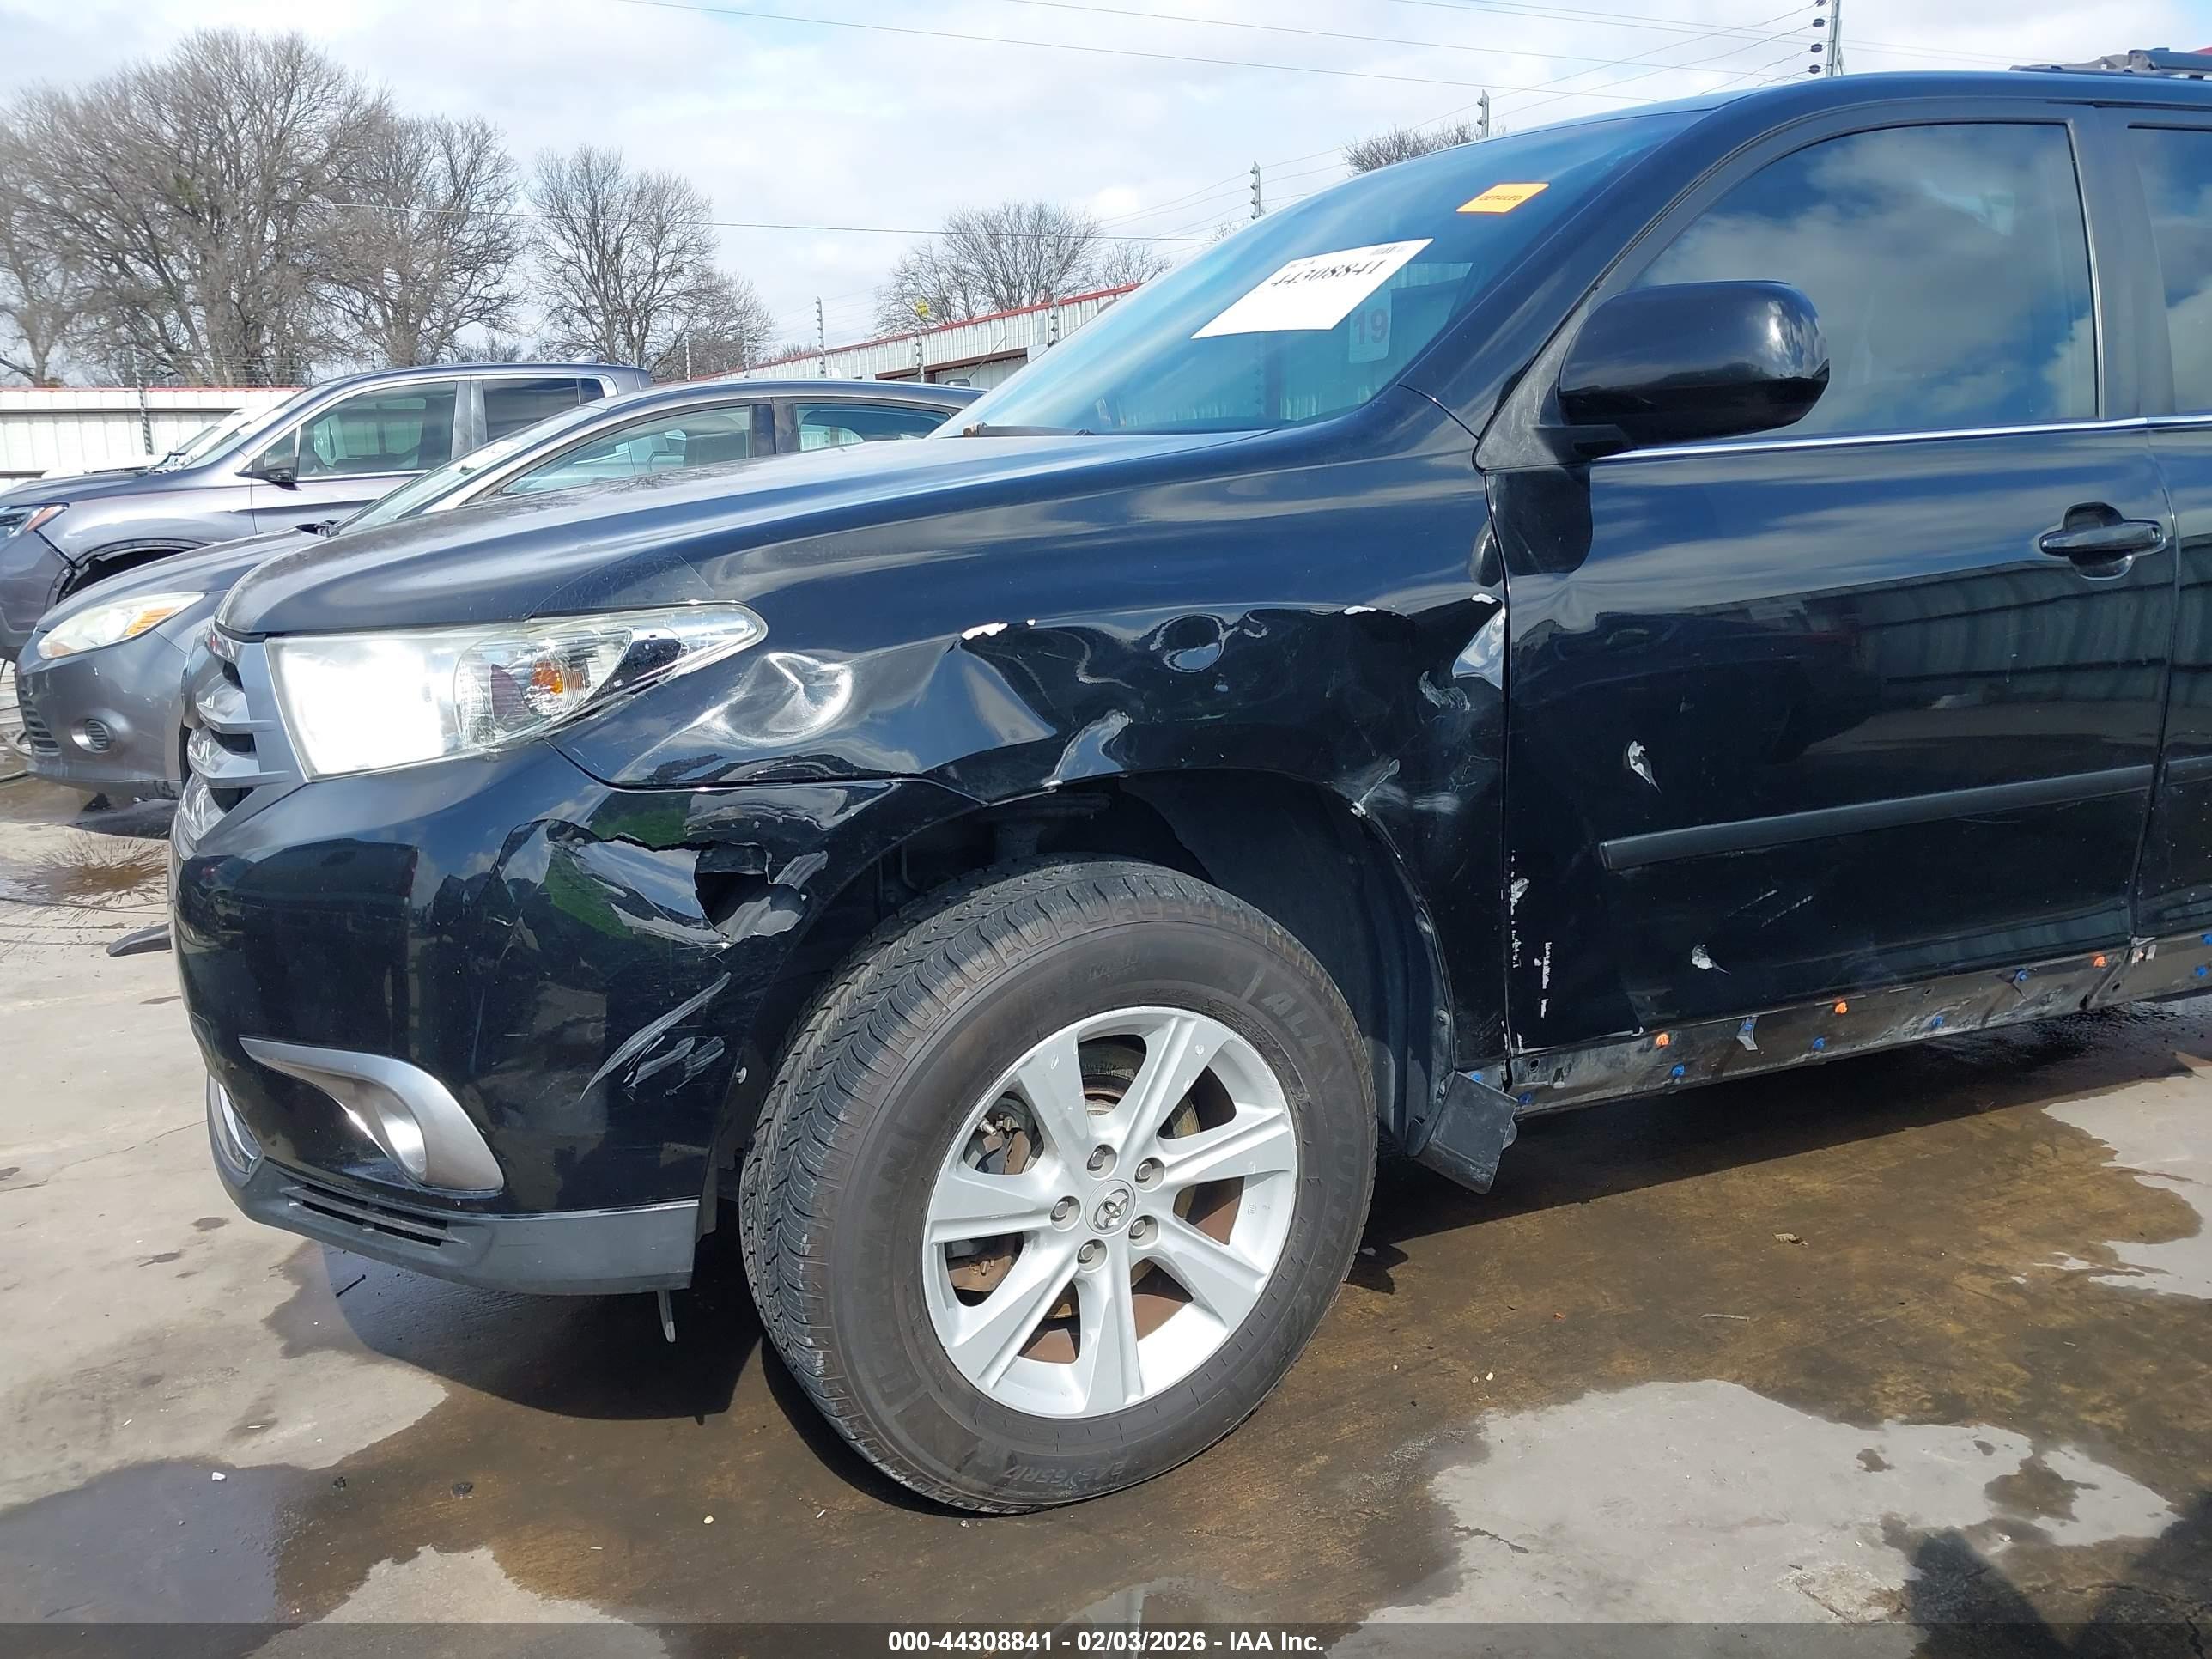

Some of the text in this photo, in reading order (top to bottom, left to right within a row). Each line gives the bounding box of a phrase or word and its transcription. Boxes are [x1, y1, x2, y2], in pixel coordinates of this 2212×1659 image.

[1271, 259, 1387, 287] 44308841
[1354, 309, 1388, 344] 19
[1261, 991, 1327, 1059] ALL
